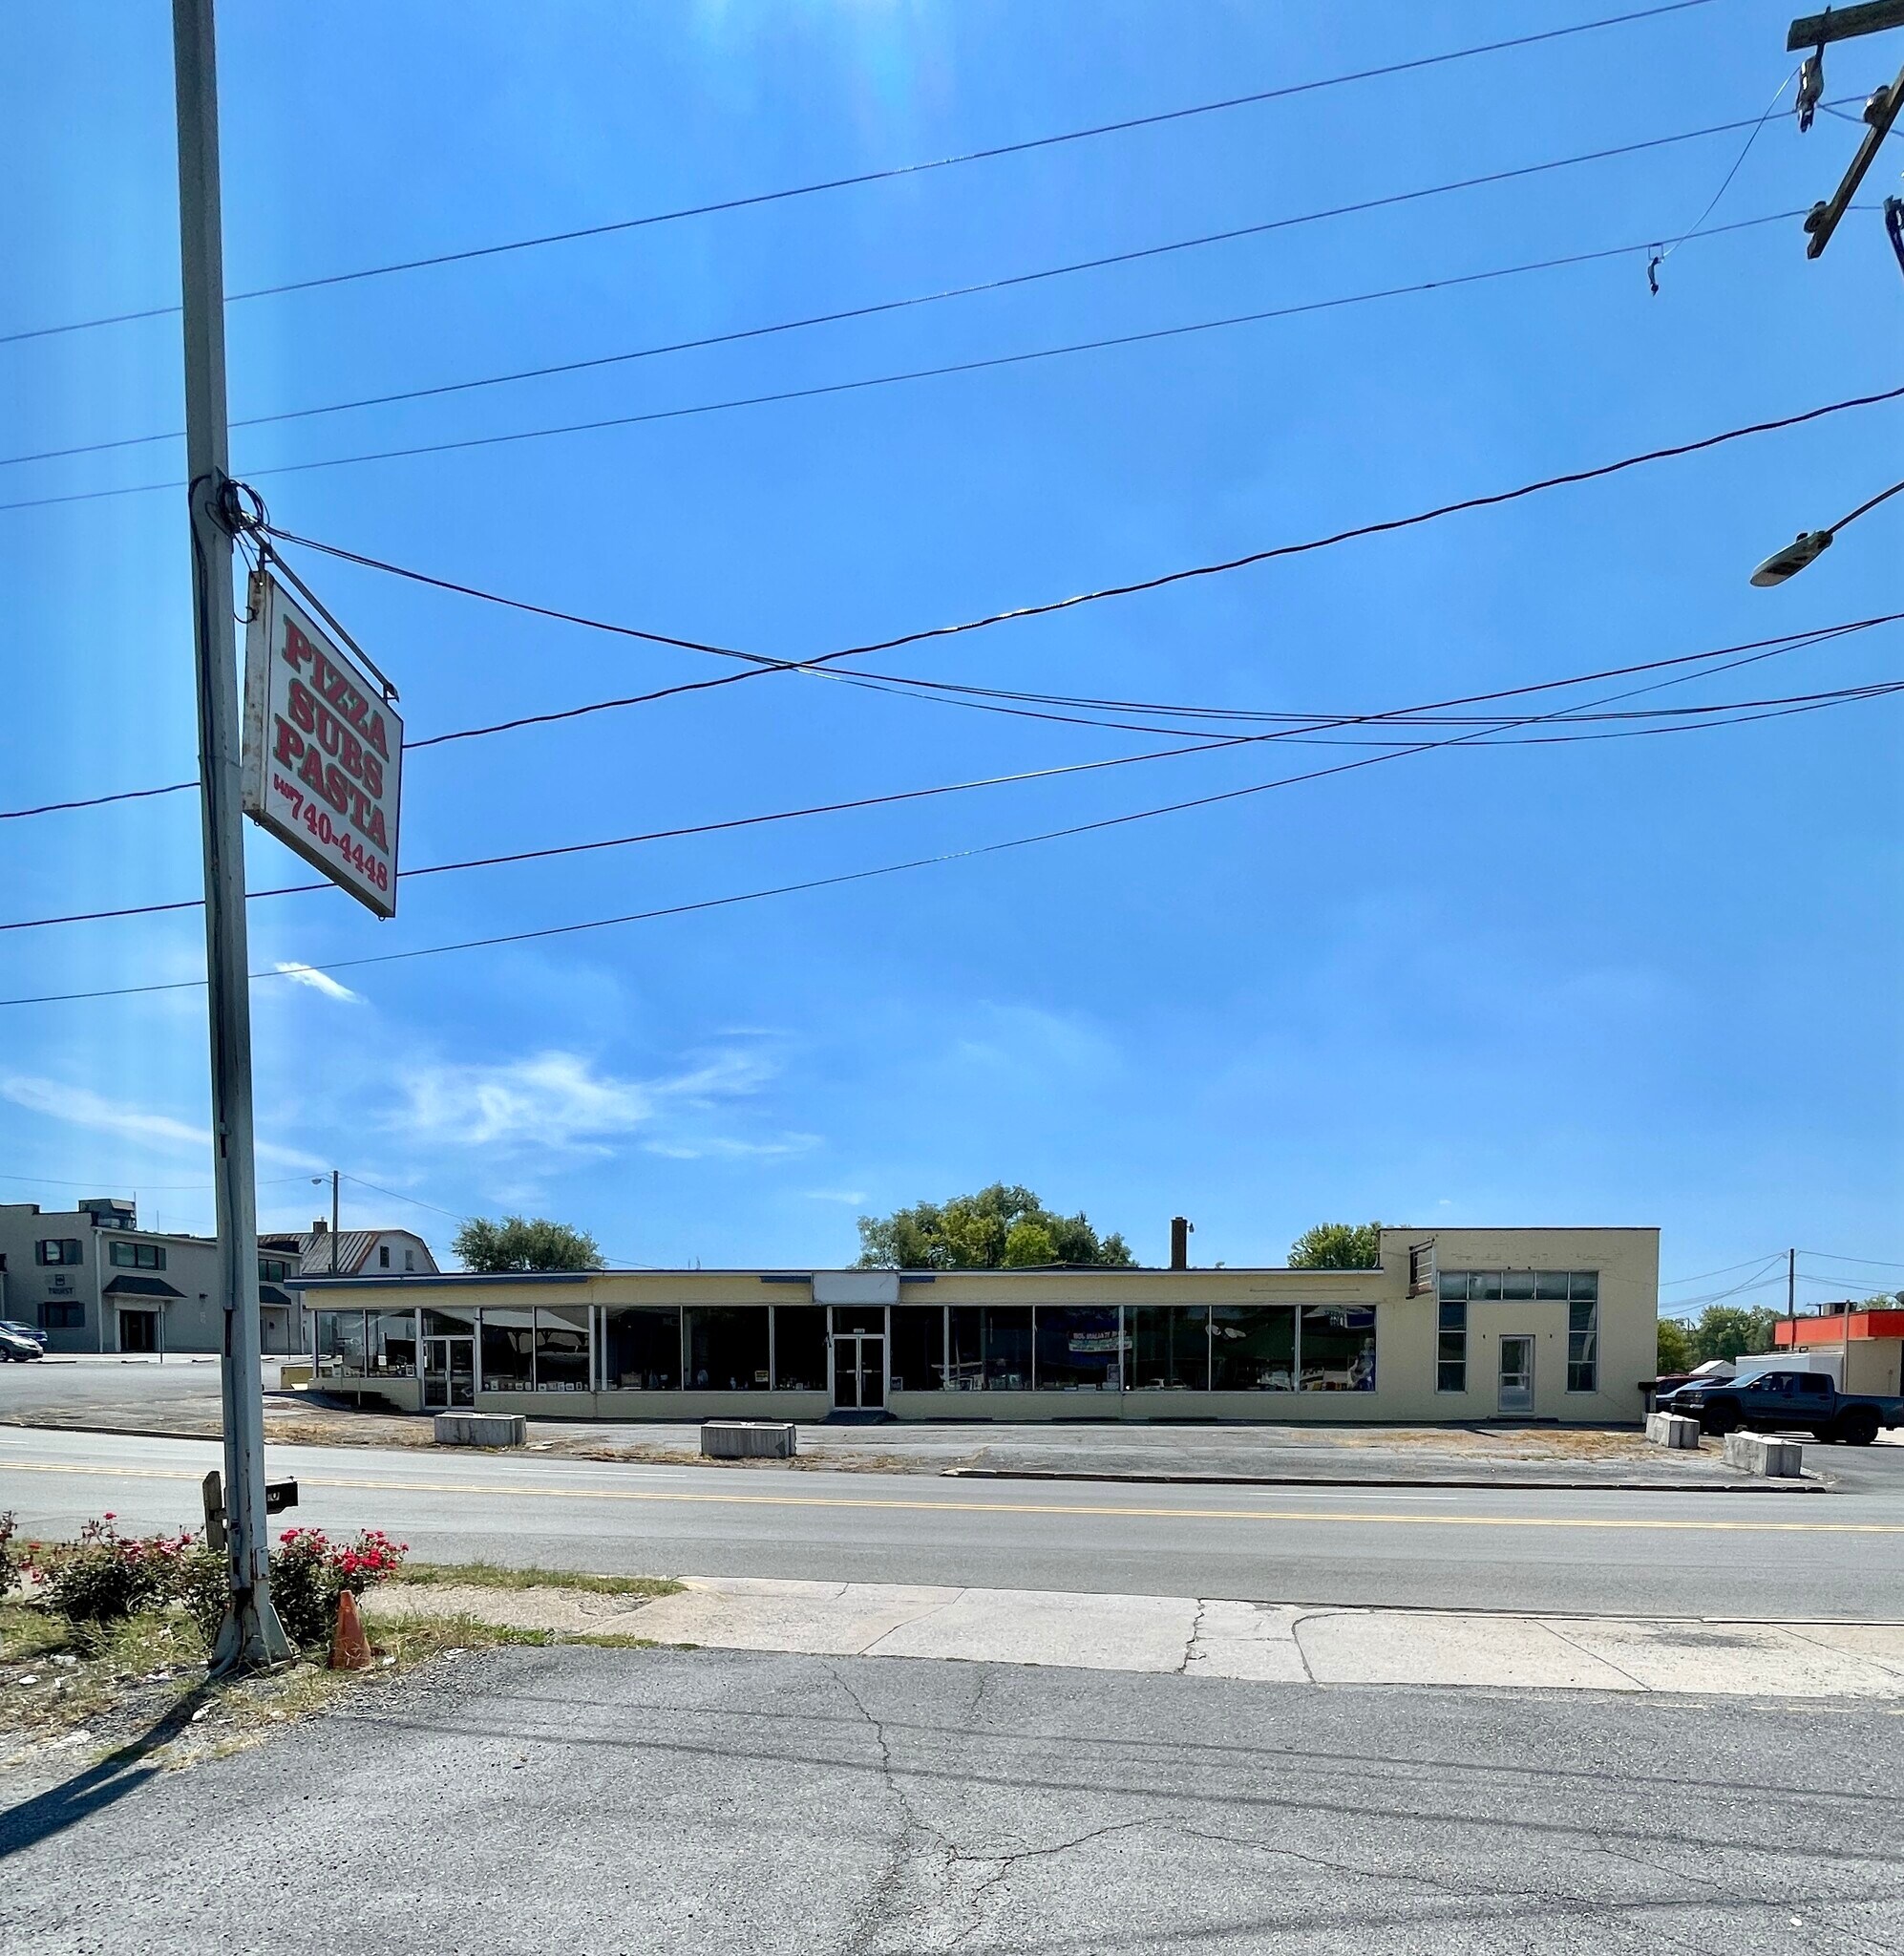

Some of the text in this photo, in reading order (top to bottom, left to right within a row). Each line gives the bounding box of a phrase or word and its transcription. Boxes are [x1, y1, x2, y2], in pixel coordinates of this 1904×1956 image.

[282, 613, 390, 763] PIZZA
[288, 677, 383, 799] SUBS
[272, 712, 389, 857] PASTA
